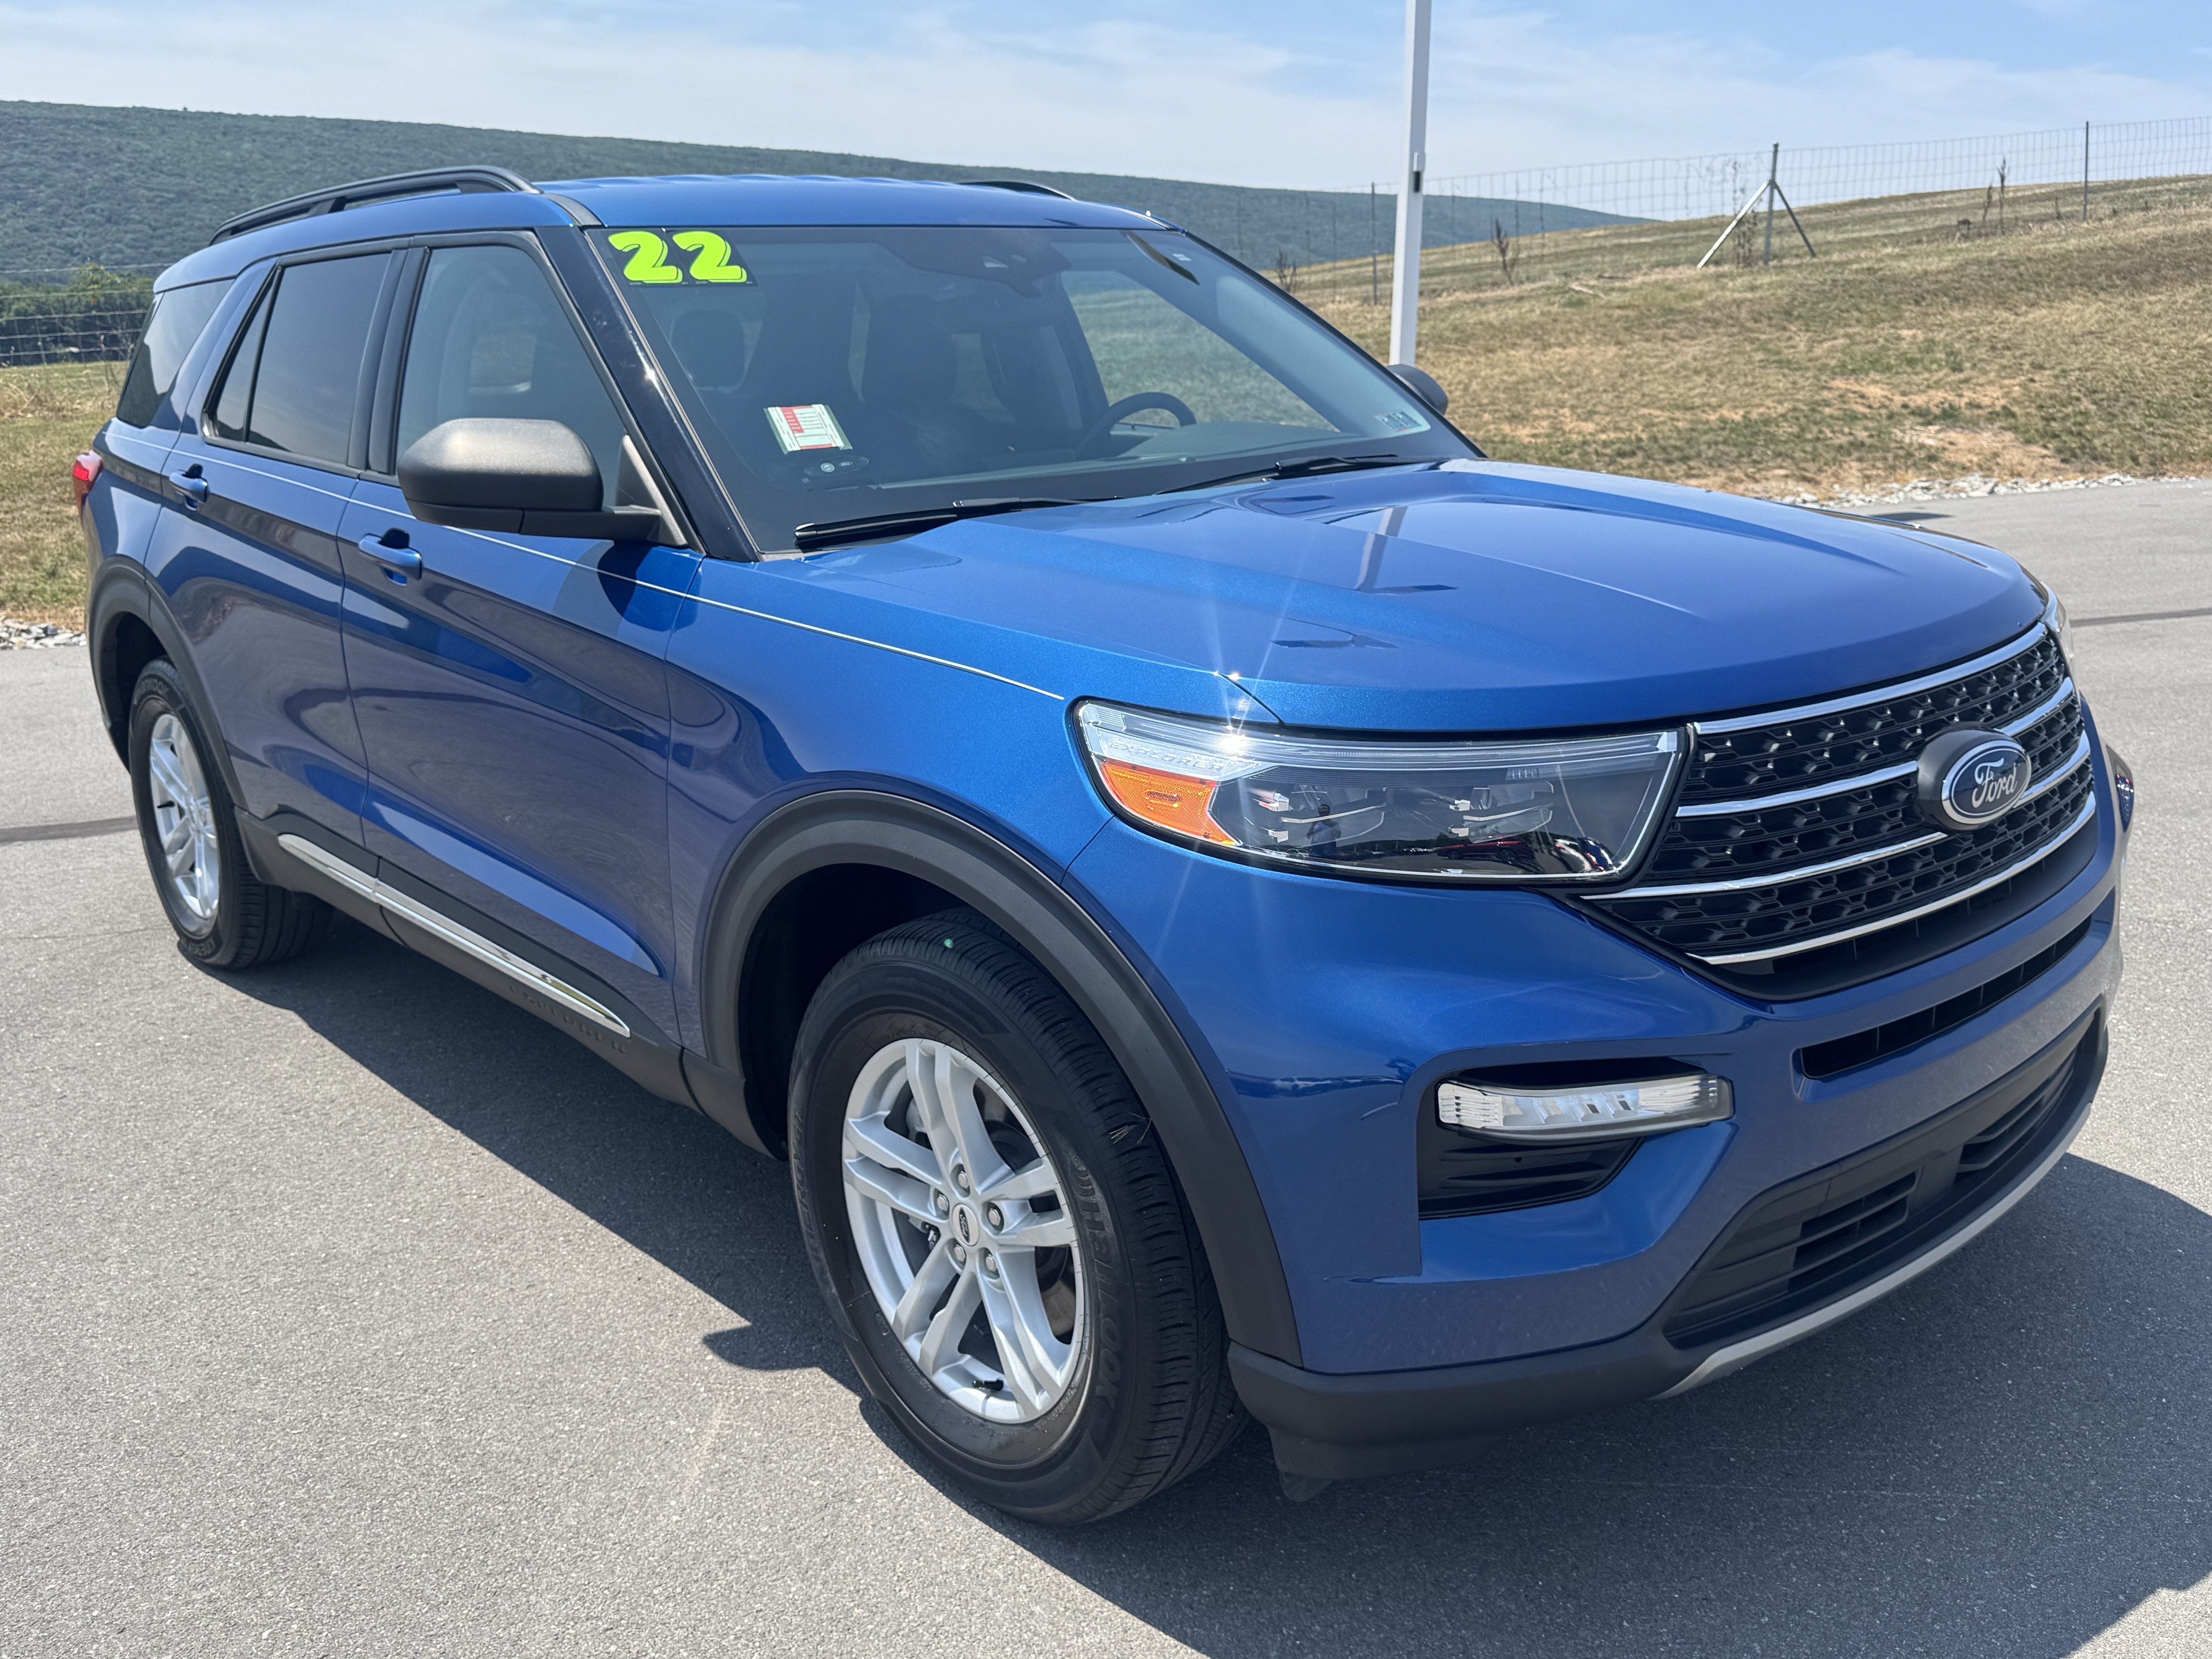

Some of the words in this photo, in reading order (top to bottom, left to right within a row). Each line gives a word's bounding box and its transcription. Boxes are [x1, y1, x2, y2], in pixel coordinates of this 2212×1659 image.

[608, 231, 747, 283] 22
[1109, 741, 1224, 771] EXPLORER
[1972, 757, 2018, 808] Ford
